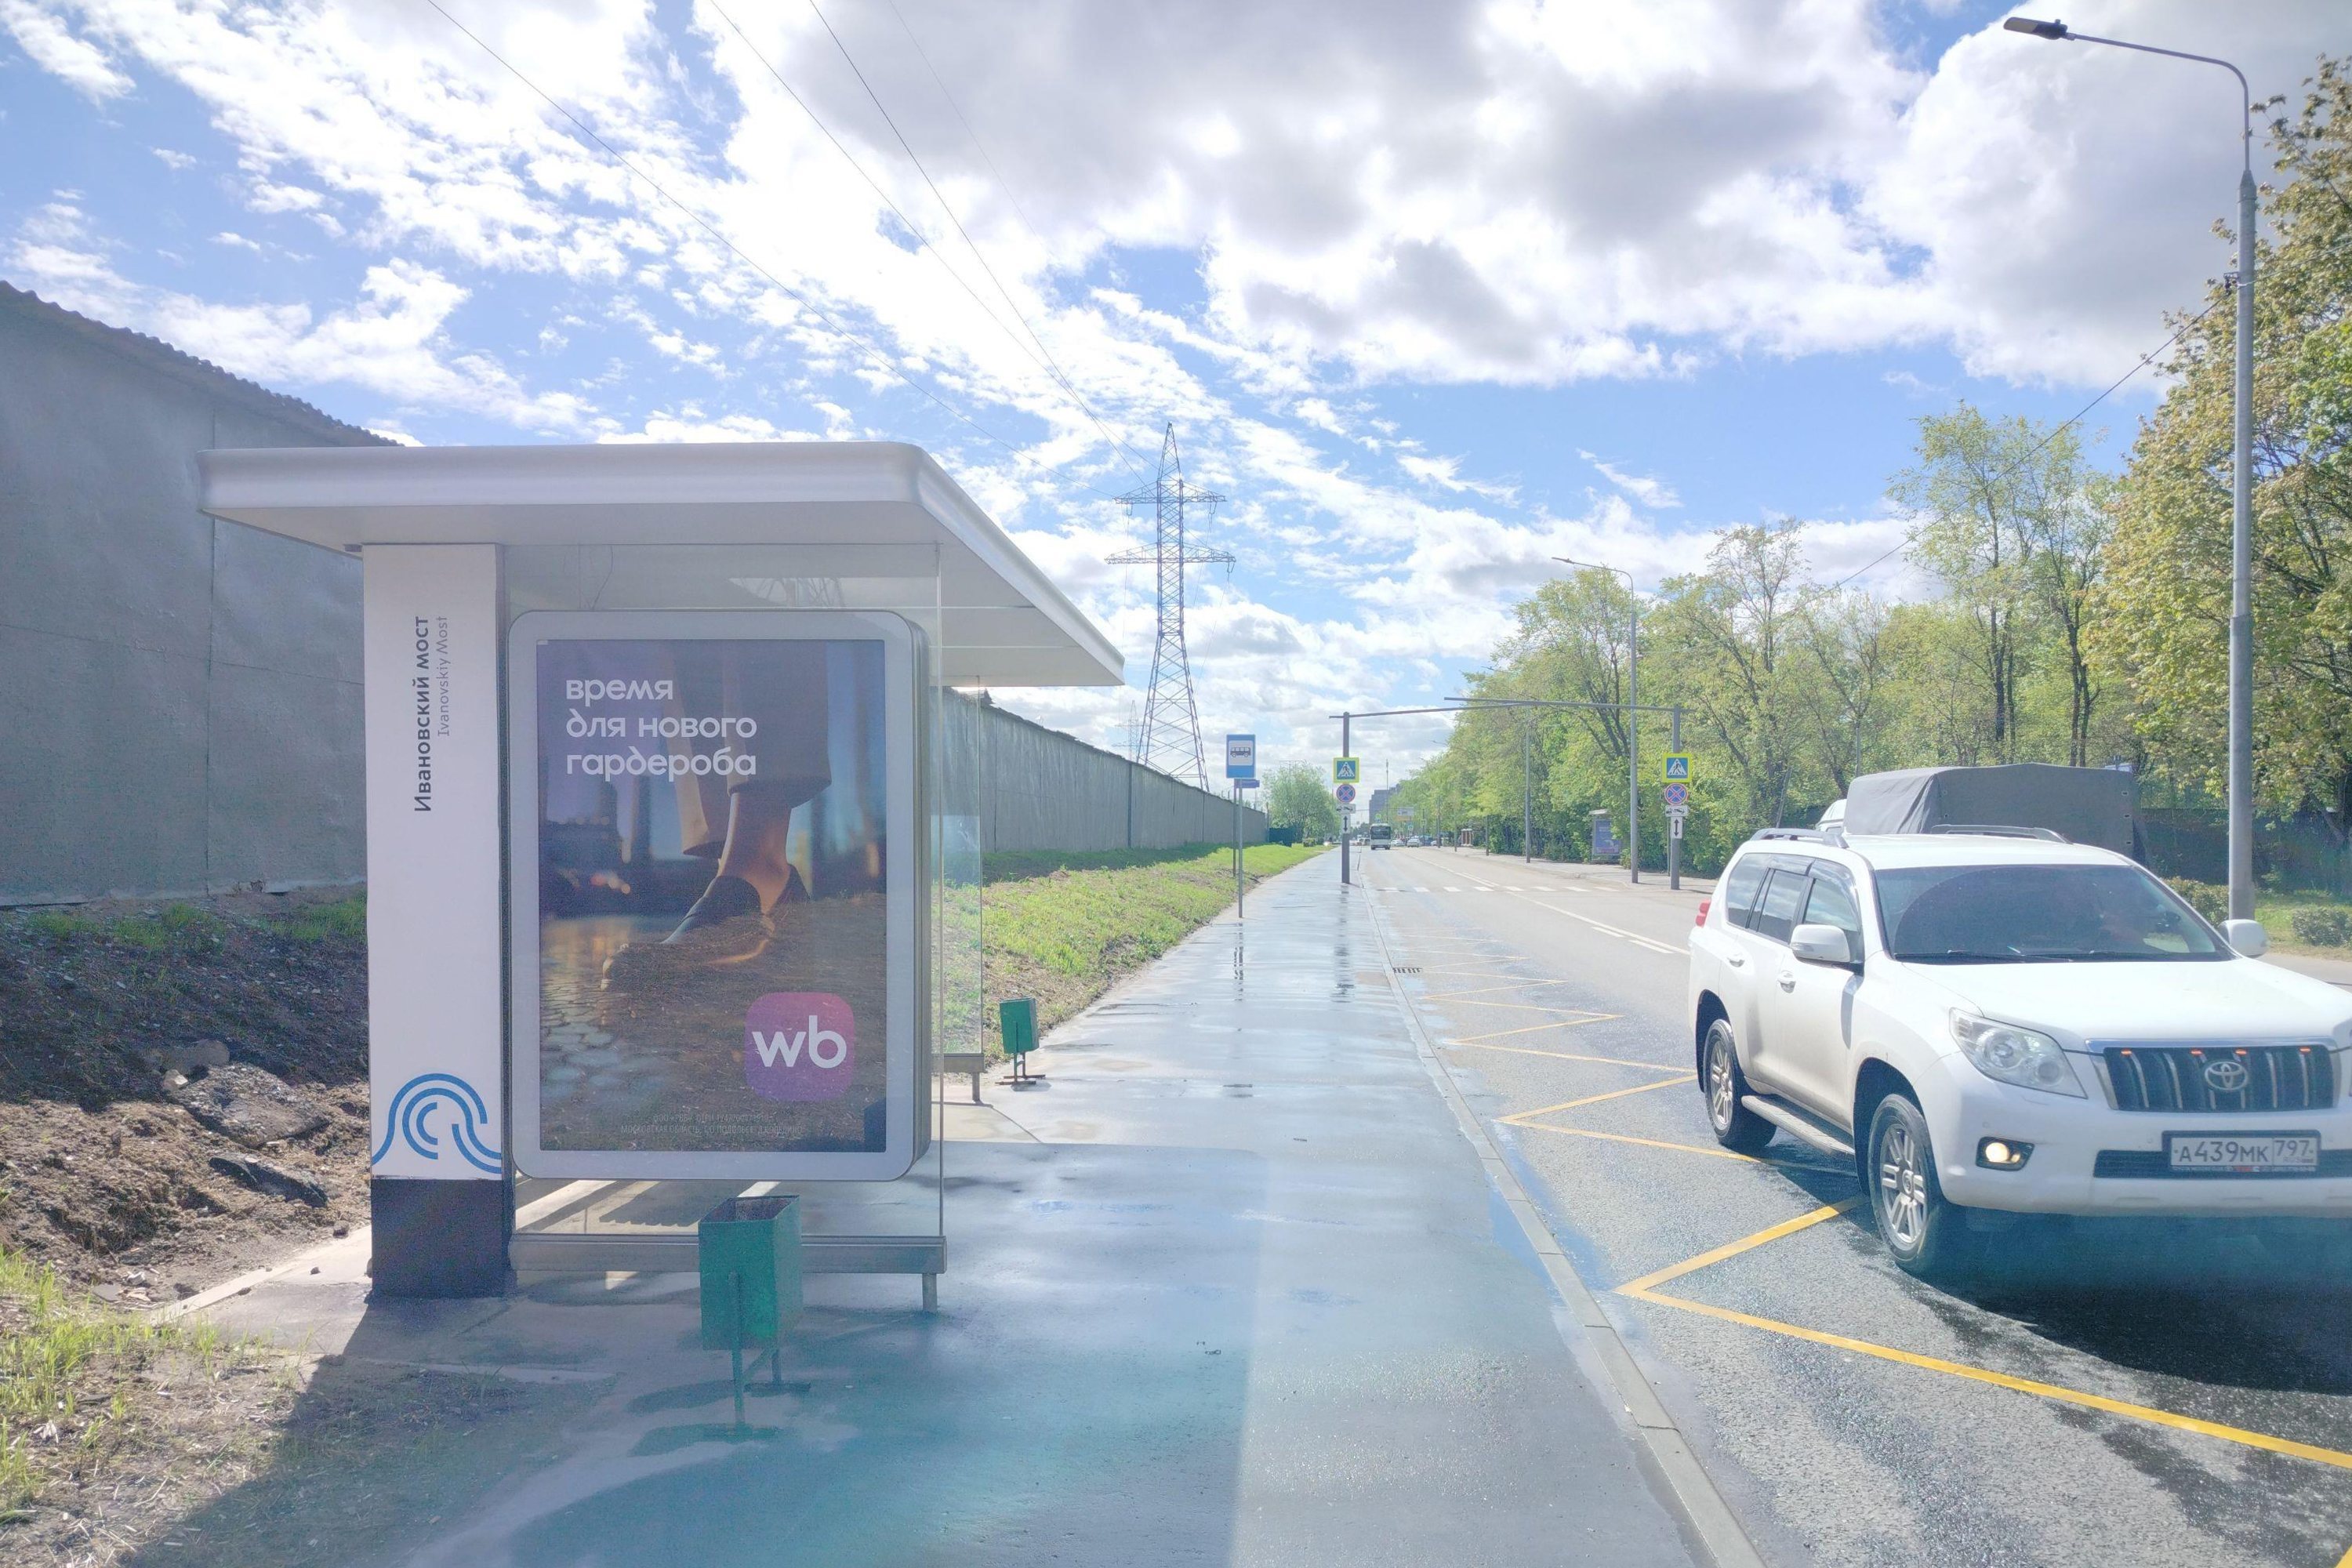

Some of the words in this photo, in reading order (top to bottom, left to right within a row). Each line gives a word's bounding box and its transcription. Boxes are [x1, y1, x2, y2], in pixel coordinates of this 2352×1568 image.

[415, 616, 430, 670] мост
[435, 616, 448, 655] Most
[436, 658, 452, 737] Ivanovskiy
[565, 678, 673, 707] время
[565, 708, 626, 739] для
[637, 716, 758, 739] нового
[412, 677, 432, 812] Ивановский
[566, 745, 757, 782] гардероба
[752, 1014, 848, 1069] wb
[2274, 1140, 2310, 1156] 797
